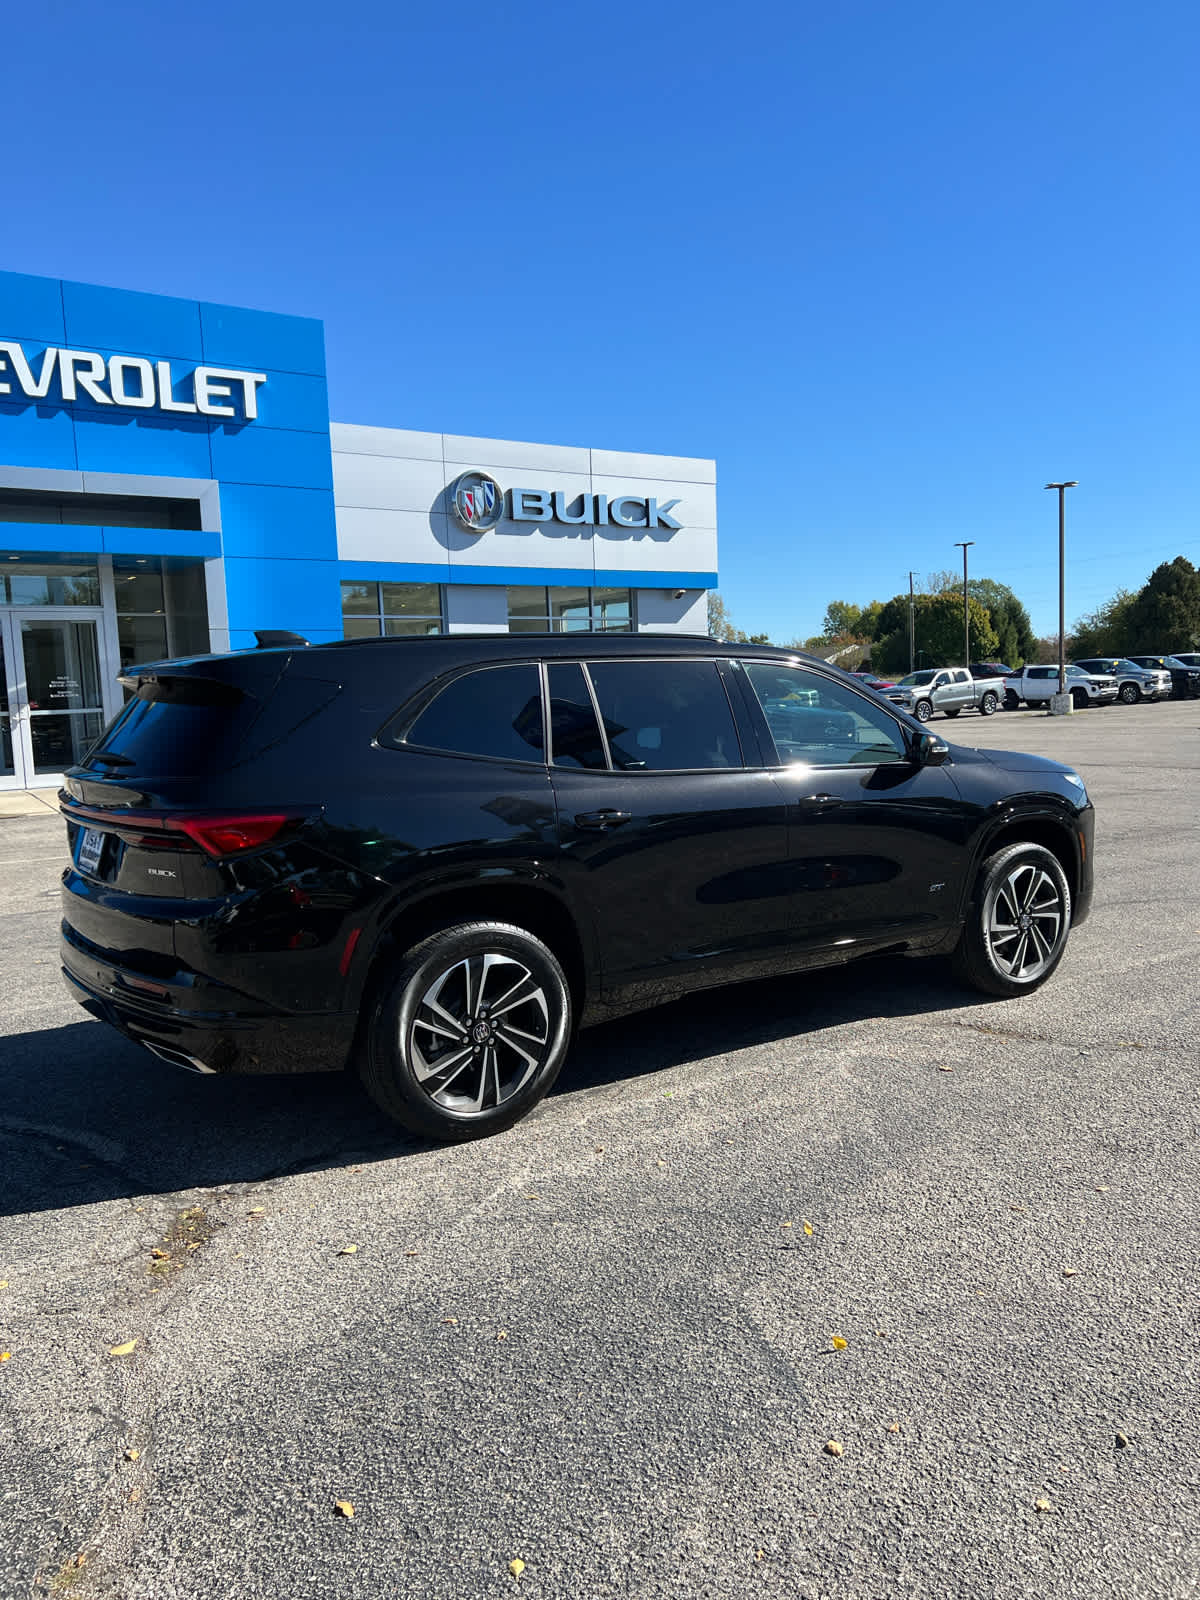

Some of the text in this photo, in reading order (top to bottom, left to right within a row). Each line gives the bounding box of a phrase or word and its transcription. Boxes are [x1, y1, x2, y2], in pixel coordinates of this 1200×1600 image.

[0, 341, 267, 420] VROLET
[507, 487, 683, 529] BUICK
[148, 868, 177, 878] BUICK
